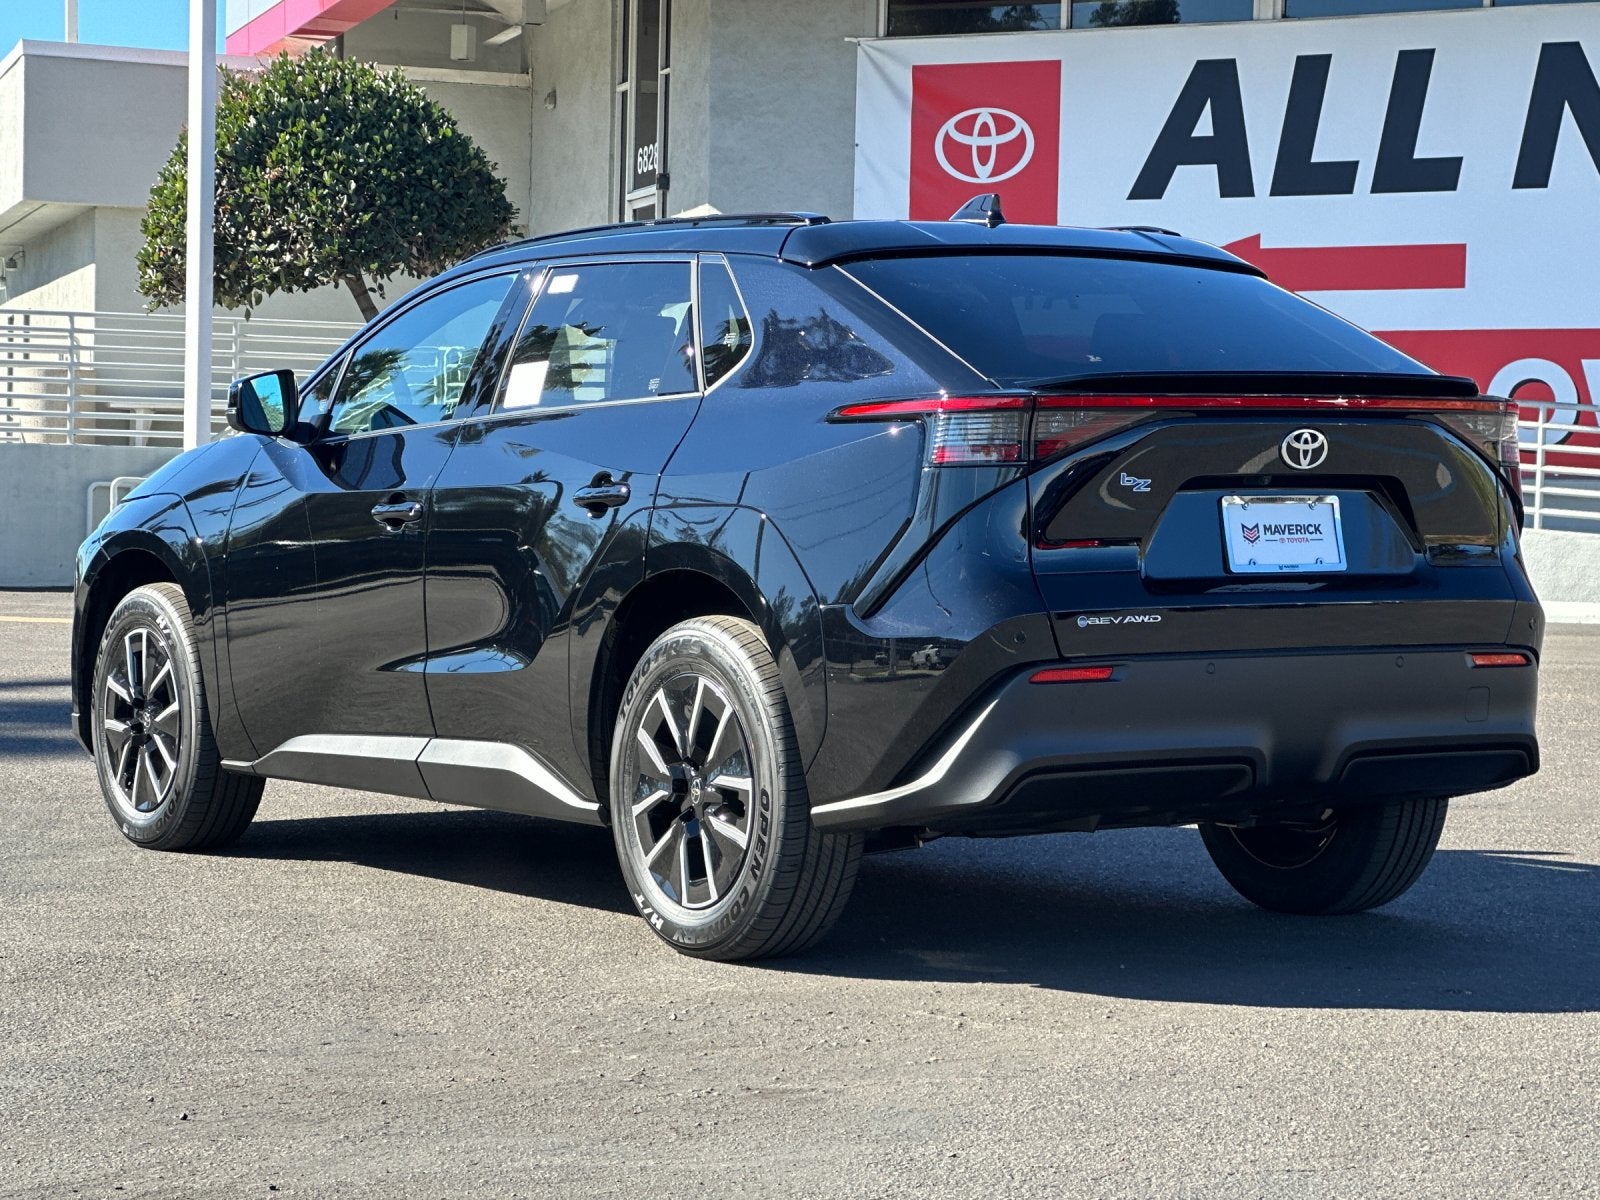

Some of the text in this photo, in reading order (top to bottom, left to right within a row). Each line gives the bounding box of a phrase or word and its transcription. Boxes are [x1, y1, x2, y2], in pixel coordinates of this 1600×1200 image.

[1126, 48, 1464, 200] ALL
[1263, 523, 1323, 536] MAVERICK
[1123, 614, 1162, 624] AWD
[619, 661, 652, 721] TOYO
[634, 787, 771, 944] OPEN COUNTRY H/T
